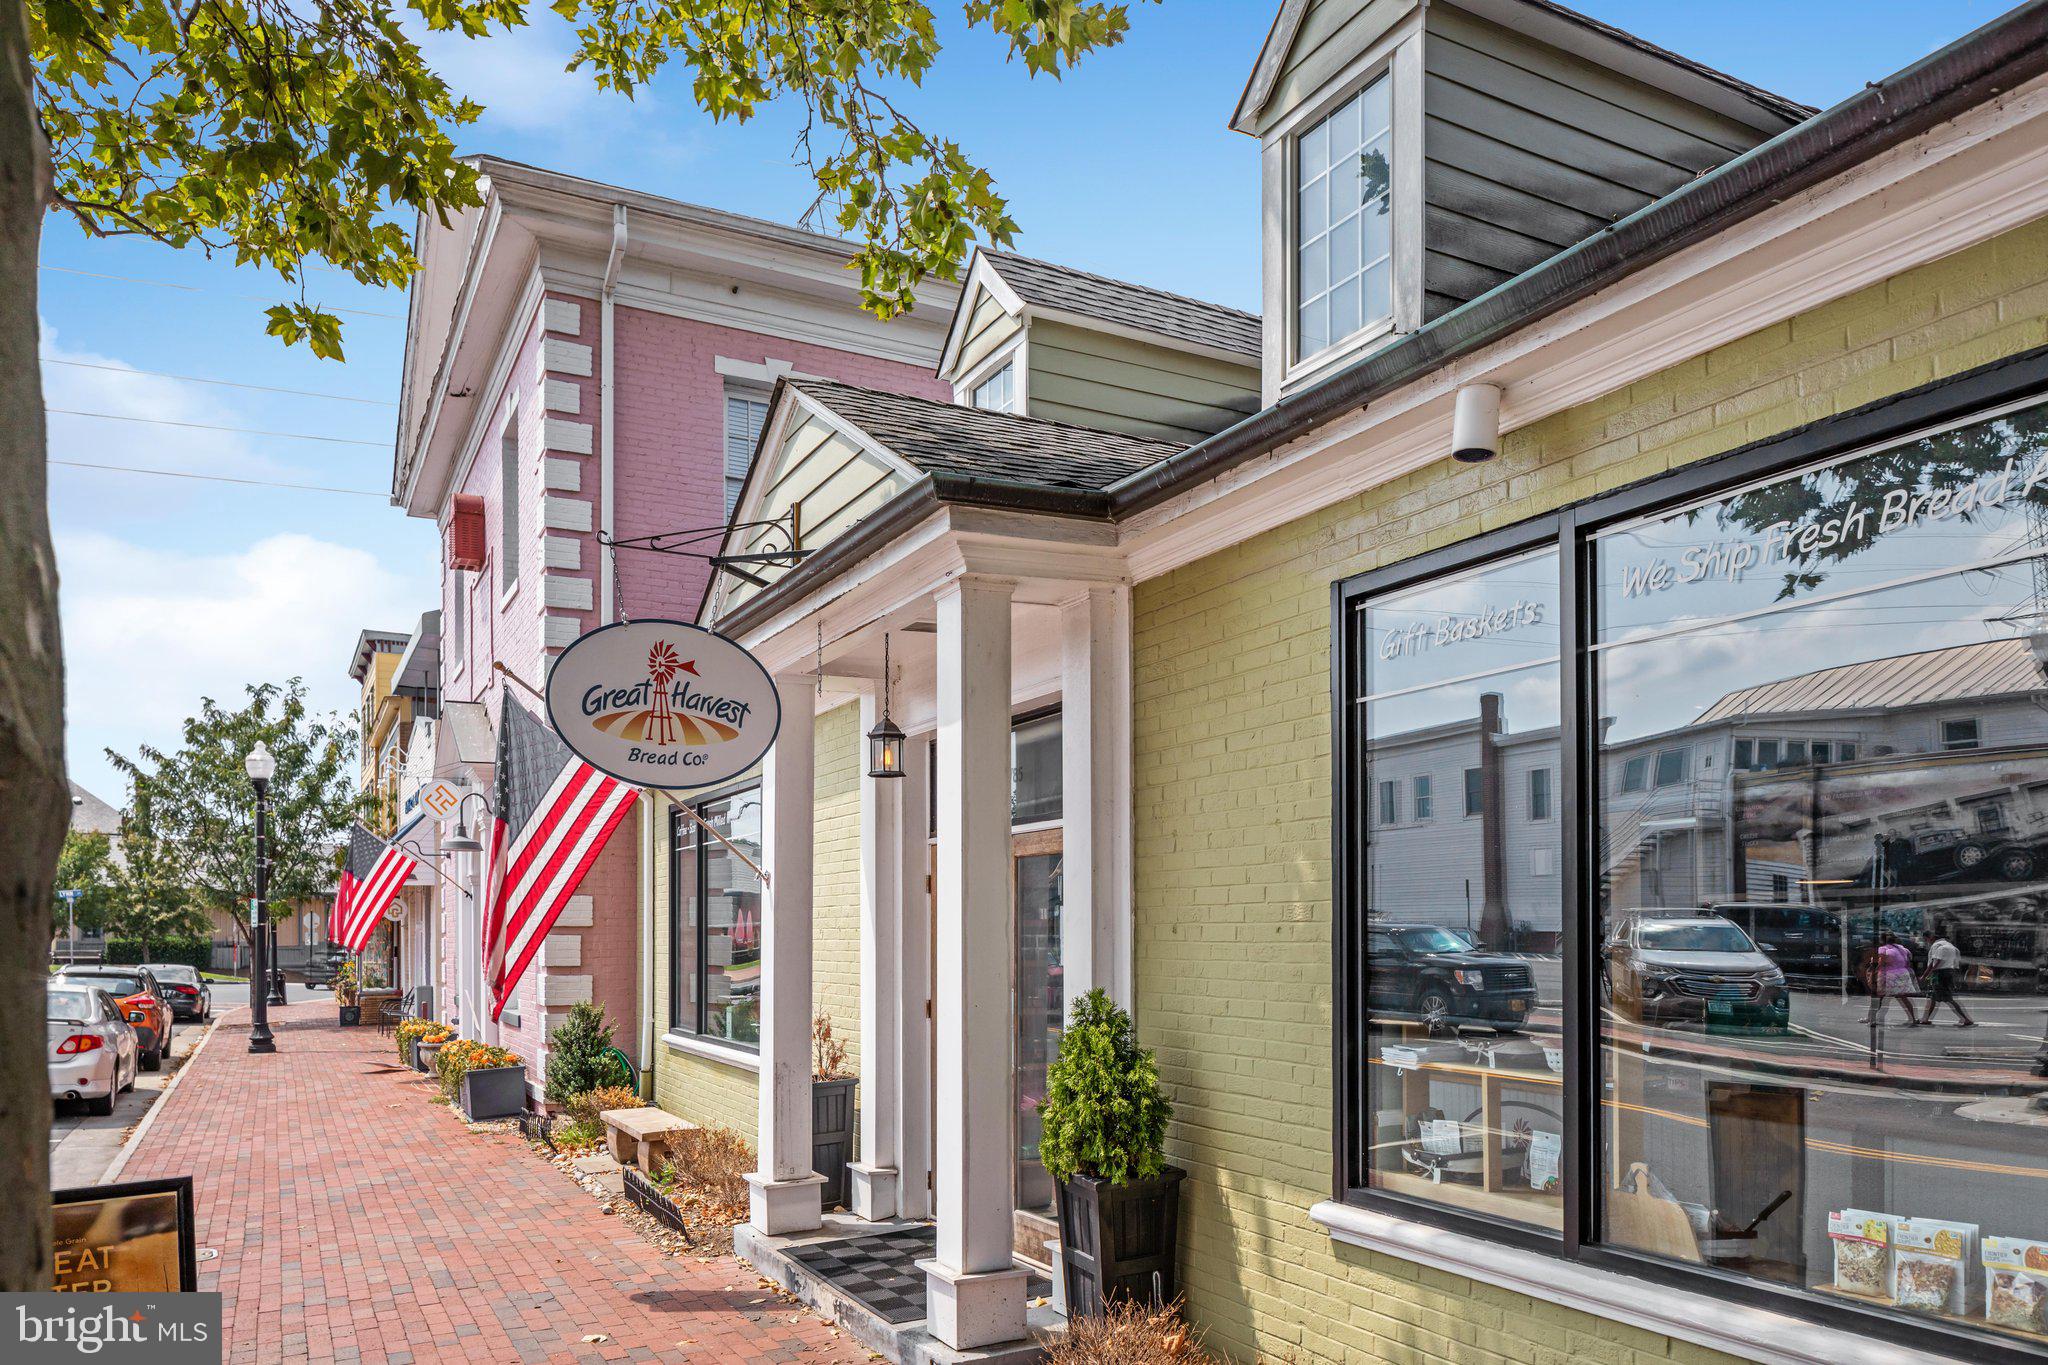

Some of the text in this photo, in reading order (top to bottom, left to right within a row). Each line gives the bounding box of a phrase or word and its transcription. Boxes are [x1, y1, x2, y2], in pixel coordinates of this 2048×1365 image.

[1622, 557, 1668, 599] We
[1678, 541, 1751, 583] Ship
[1762, 502, 1864, 565] Fresh
[1879, 457, 2014, 534] Bread
[1380, 599, 1539, 661] Gift Baskets
[581, 678, 752, 729] Great Harvest
[627, 747, 678, 766] Bread
